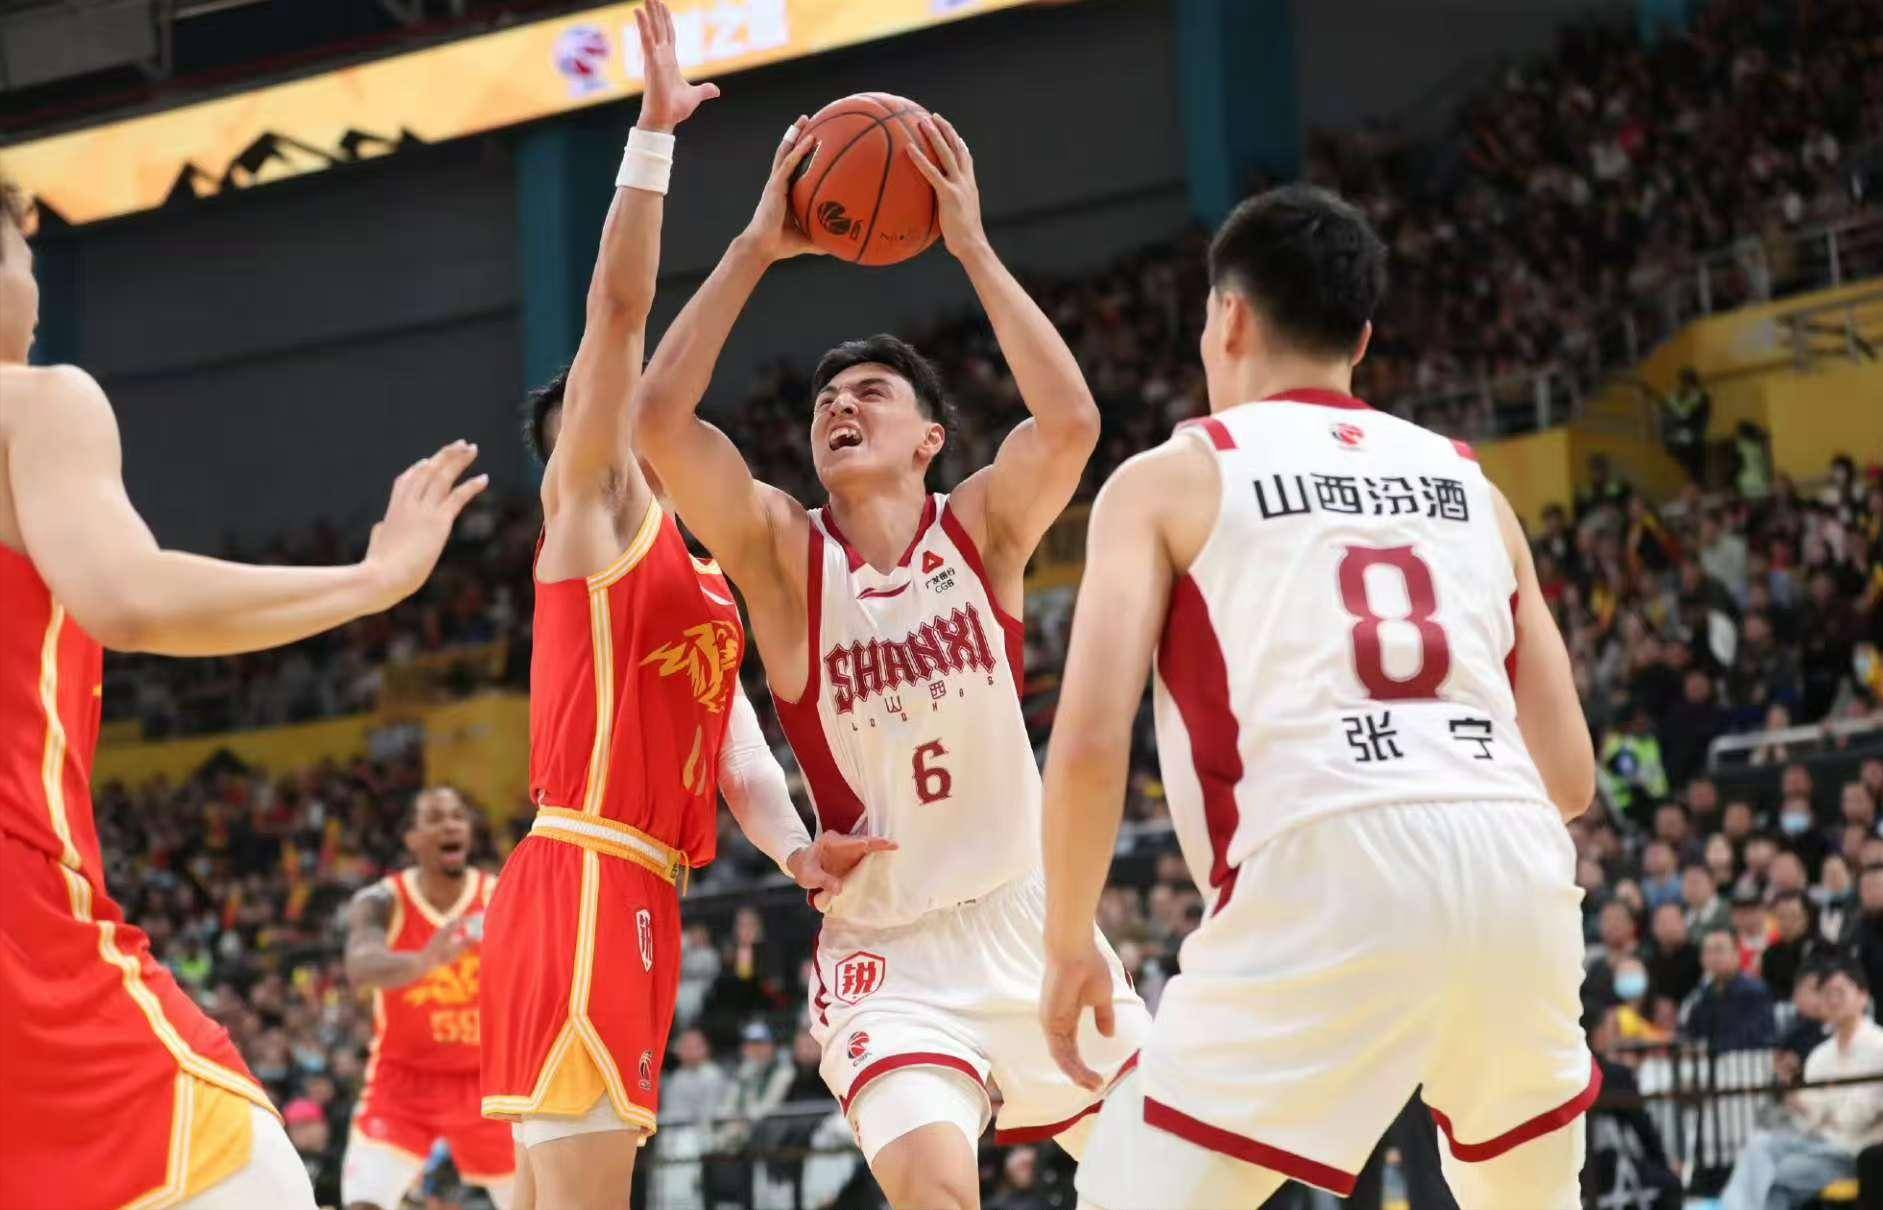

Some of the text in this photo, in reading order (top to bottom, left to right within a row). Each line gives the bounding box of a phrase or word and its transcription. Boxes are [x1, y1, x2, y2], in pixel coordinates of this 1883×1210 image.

[1253, 473, 1470, 522] 山西汾酒
[824, 602, 996, 715] SHANXI
[1337, 544, 1452, 701] 8
[911, 738, 953, 807] 6
